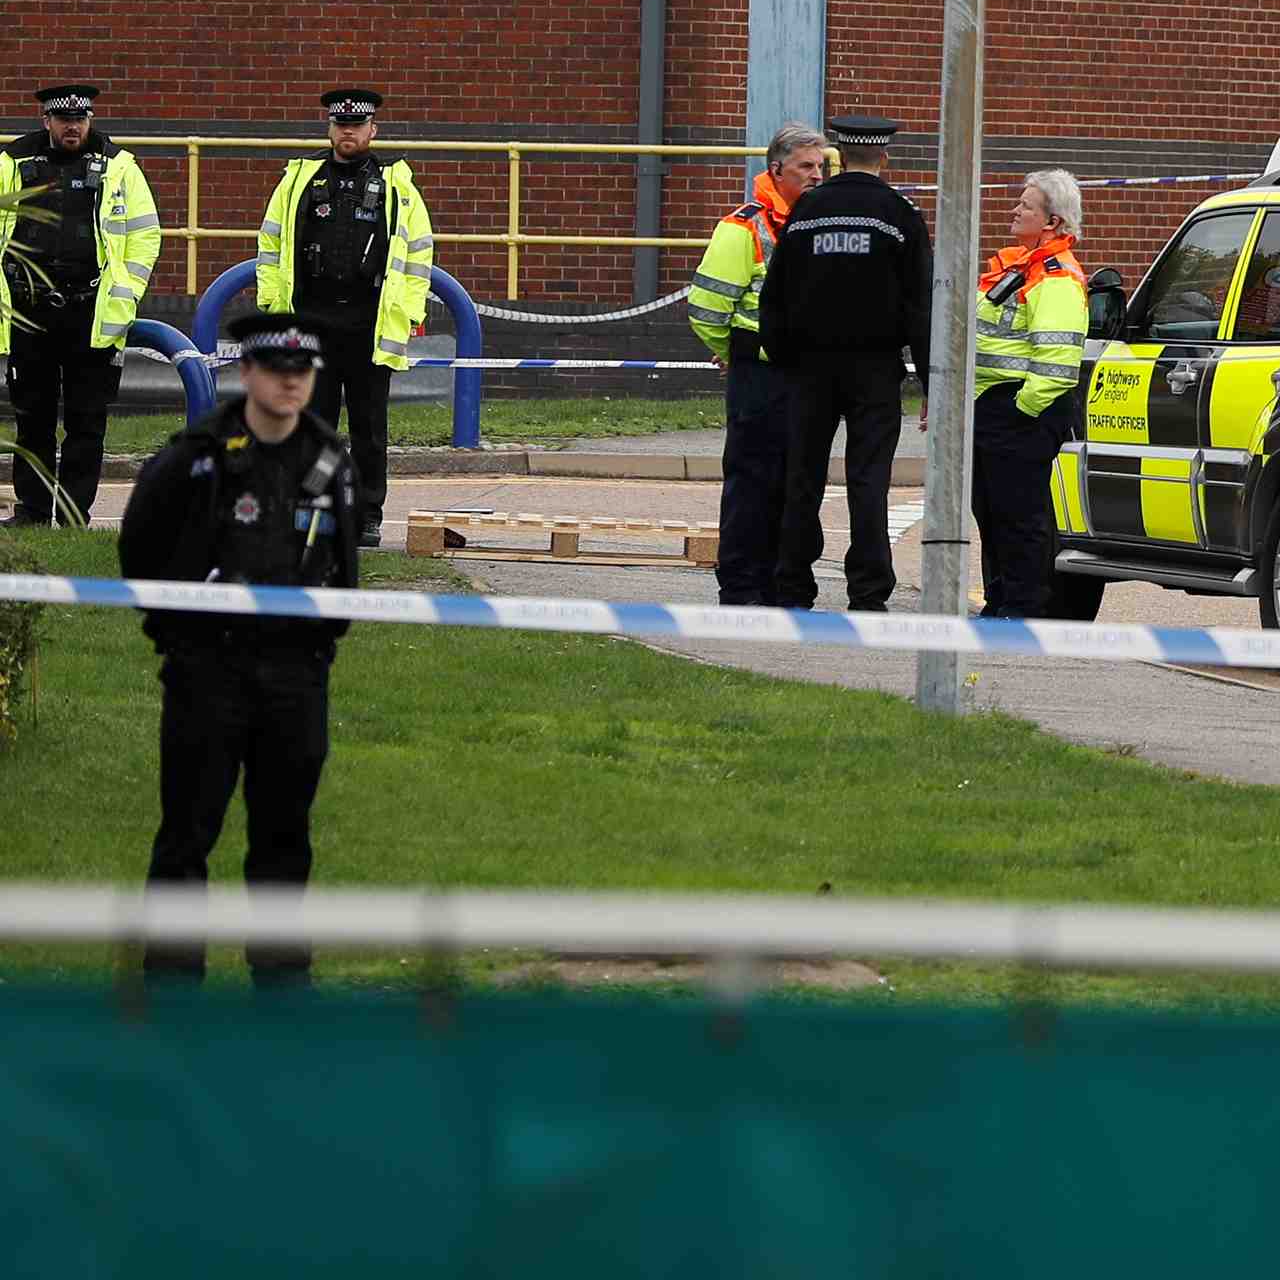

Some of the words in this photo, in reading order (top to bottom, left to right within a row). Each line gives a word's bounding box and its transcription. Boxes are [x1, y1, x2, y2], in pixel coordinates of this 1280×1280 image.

[813, 232, 871, 255] POLICE
[1107, 369, 1141, 389] highways
[1088, 414, 1115, 429] TRAFFIC
[1117, 416, 1146, 431] OFFICER
